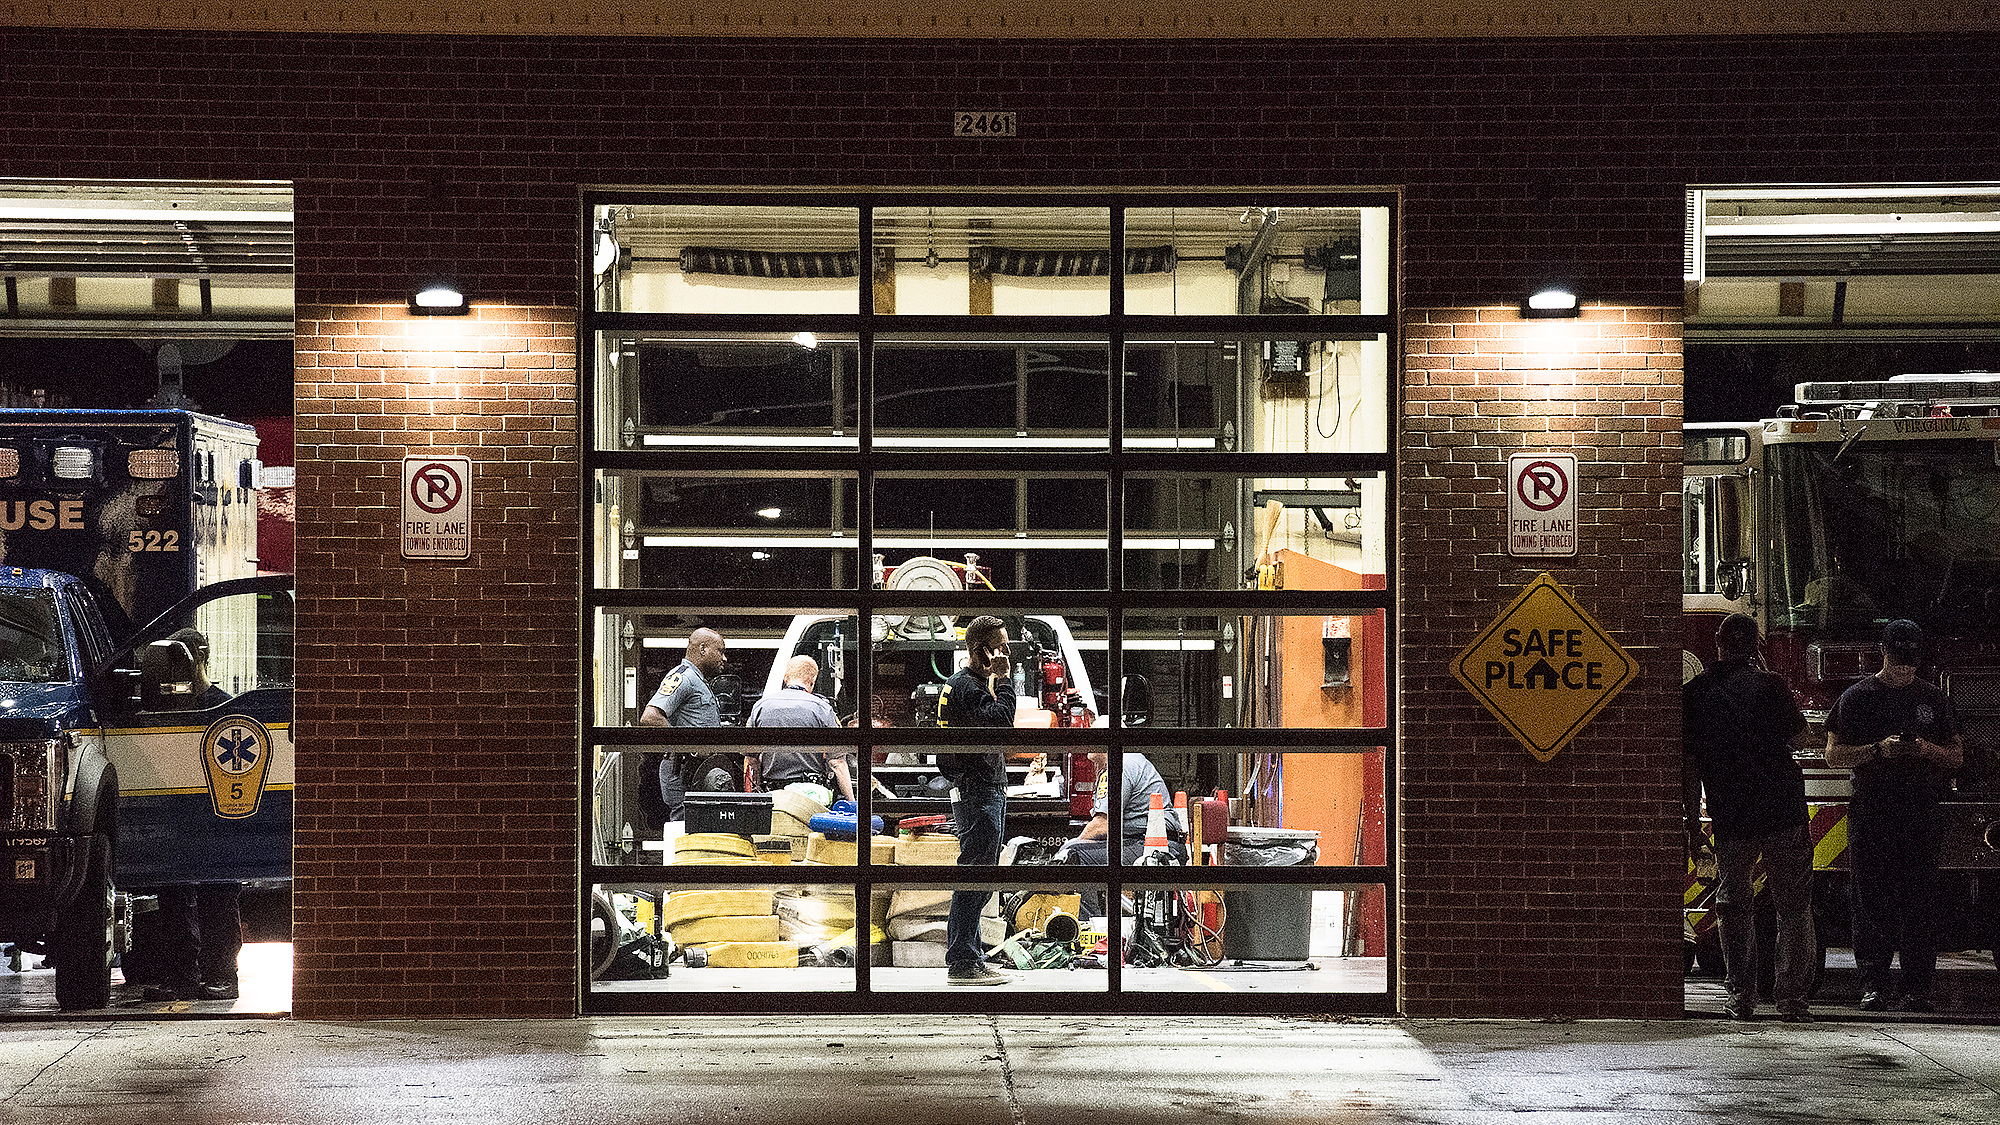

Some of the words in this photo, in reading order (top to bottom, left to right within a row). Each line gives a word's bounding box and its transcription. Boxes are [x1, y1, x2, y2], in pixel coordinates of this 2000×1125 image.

[960, 114, 1010, 134] 2461
[1894, 418, 1971, 433] VIRGINIA
[0, 500, 85, 530] USE
[406, 521, 431, 535] FIRE
[436, 521, 466, 535] LANE
[1513, 519, 1538, 532] FIRE
[1542, 519, 1573, 532] LANE
[128, 530, 179, 552] 522
[406, 537, 431, 551] TOWING
[432, 537, 466, 551] ENFORCED
[1513, 534, 1538, 548] TOWING
[1540, 534, 1573, 548] ENFORCED
[1502, 628, 1583, 657] SAFE
[230, 783, 243, 800] 5
[719, 811, 735, 820] HM
